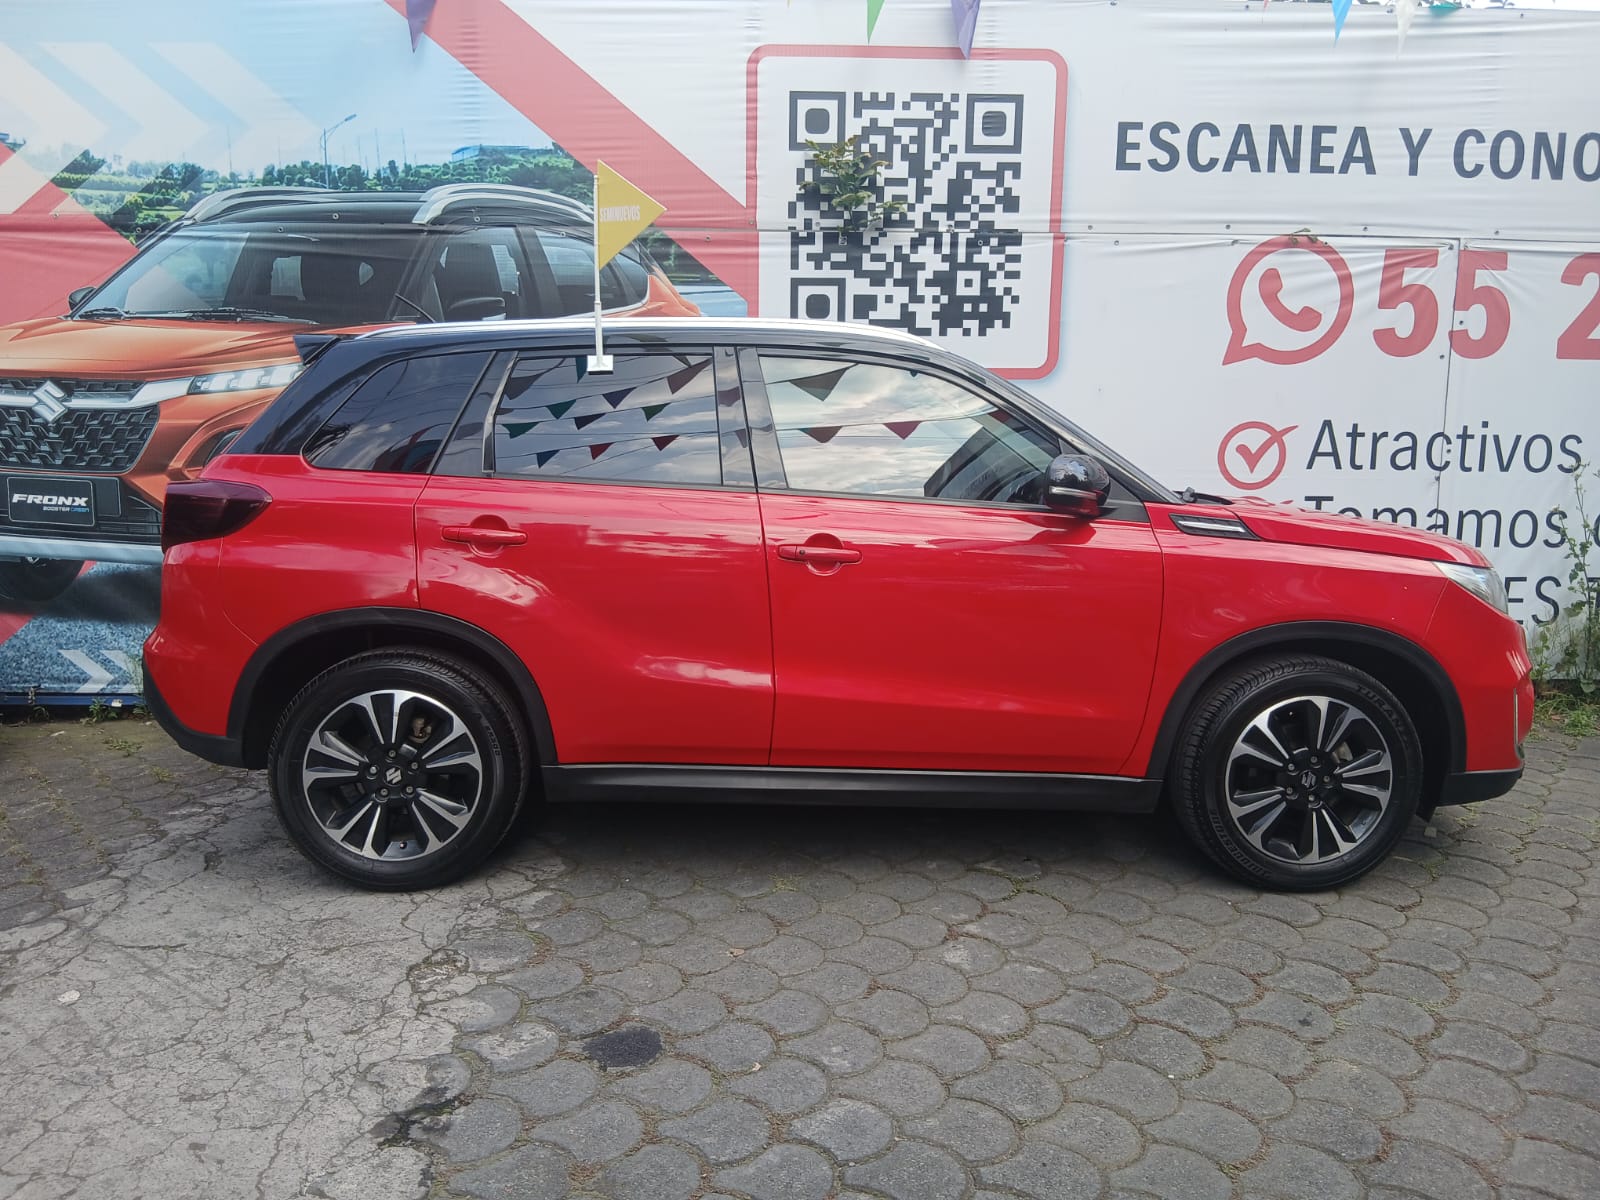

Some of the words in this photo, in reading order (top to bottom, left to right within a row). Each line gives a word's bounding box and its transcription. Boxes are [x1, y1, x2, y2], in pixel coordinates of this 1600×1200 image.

[1115, 121, 1377, 176] ESCANEA
[1399, 127, 1433, 177] Y
[1453, 128, 1600, 182] CONO
[1372, 248, 1511, 360] 55
[1556, 252, 1600, 360] 2
[1306, 419, 1583, 474] Atractivos
[12, 493, 88, 506] FRONX
